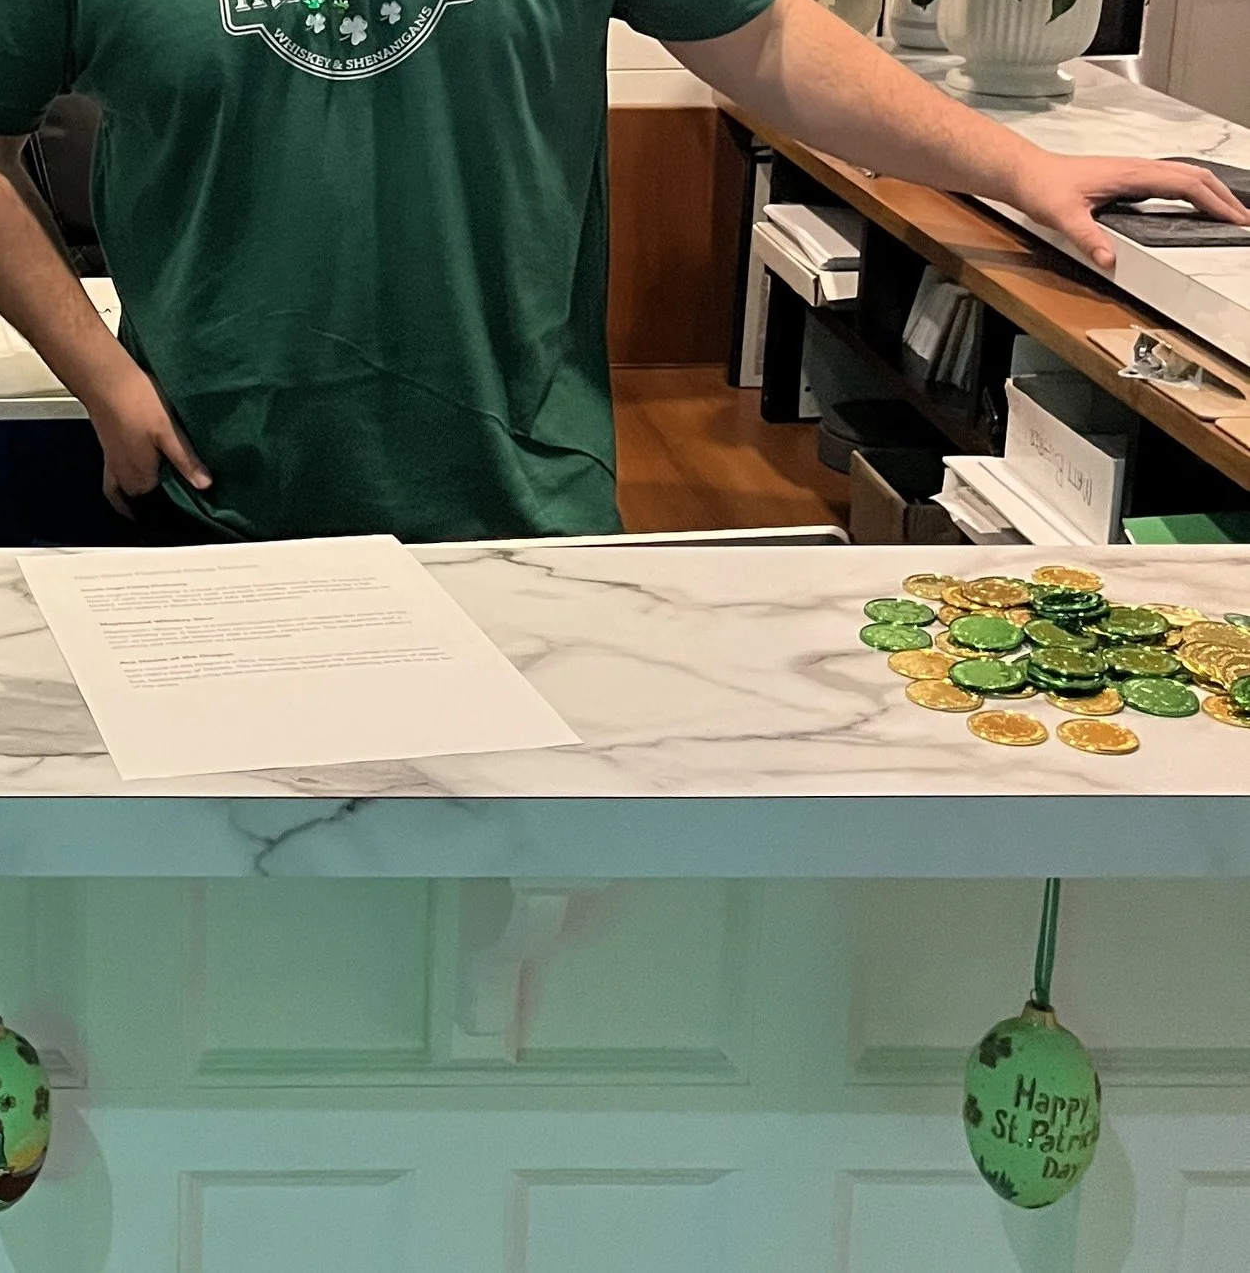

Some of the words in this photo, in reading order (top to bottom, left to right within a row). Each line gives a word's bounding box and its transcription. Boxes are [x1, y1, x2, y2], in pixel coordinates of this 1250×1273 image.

[273, 27, 332, 70] WHISKEY
[333, 59, 344, 70] &
[345, 5, 433, 70] SHENANIGANS
[1014, 1074, 1090, 1128] Happy
[1042, 1156, 1083, 1183] Day
